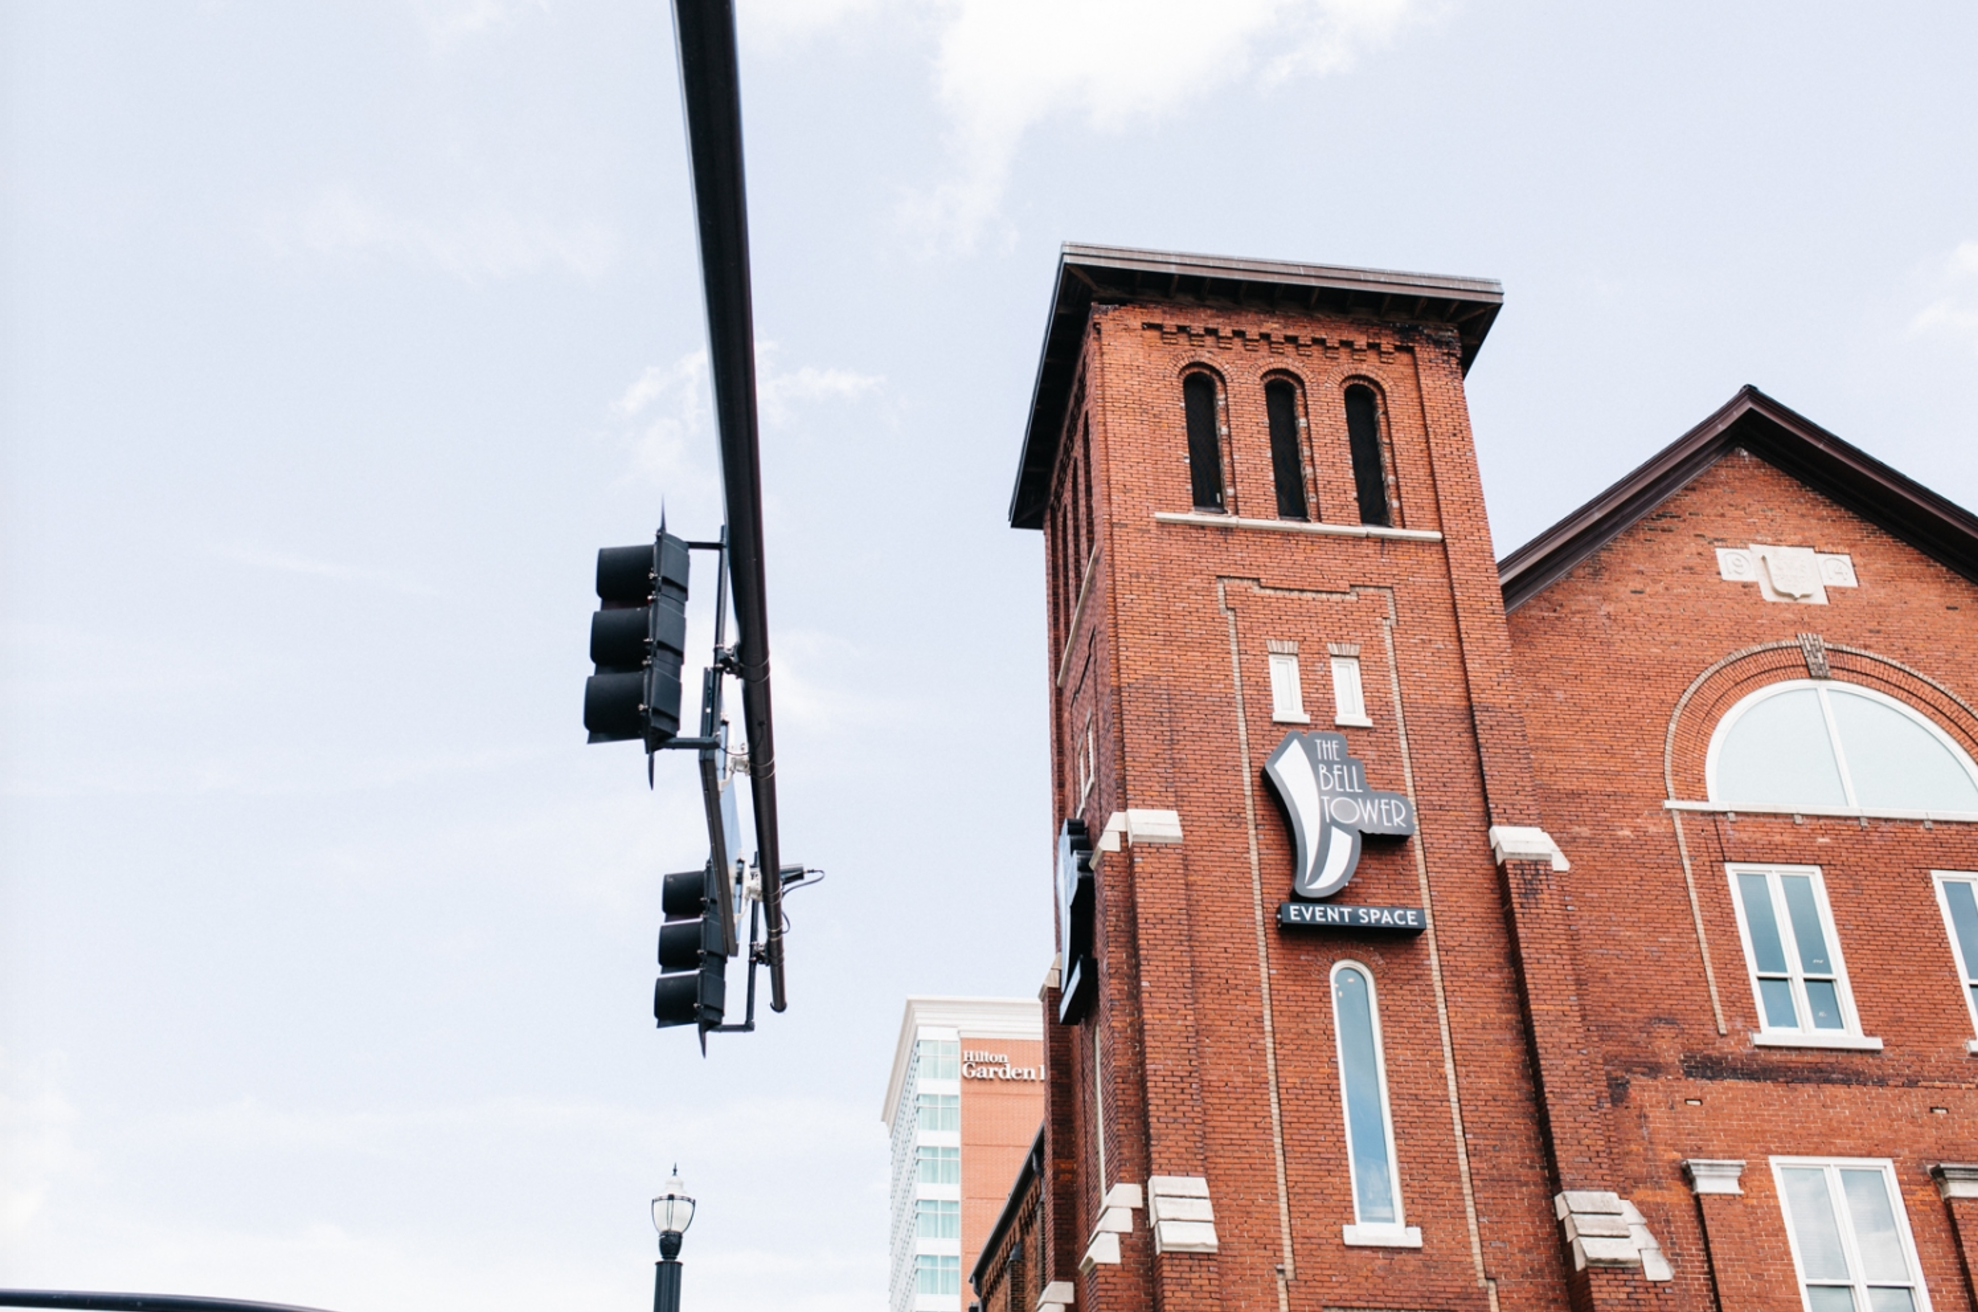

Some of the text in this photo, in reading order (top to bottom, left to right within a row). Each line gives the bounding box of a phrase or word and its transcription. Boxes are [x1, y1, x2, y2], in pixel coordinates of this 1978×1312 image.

[1314, 738, 1341, 761] THE
[1318, 763, 1364, 793] BELL
[1320, 794, 1407, 828] TOWER
[1289, 905, 1419, 926] EVENT SPACE
[963, 1051, 1009, 1063] Hilton
[962, 1062, 1036, 1080] Garden
